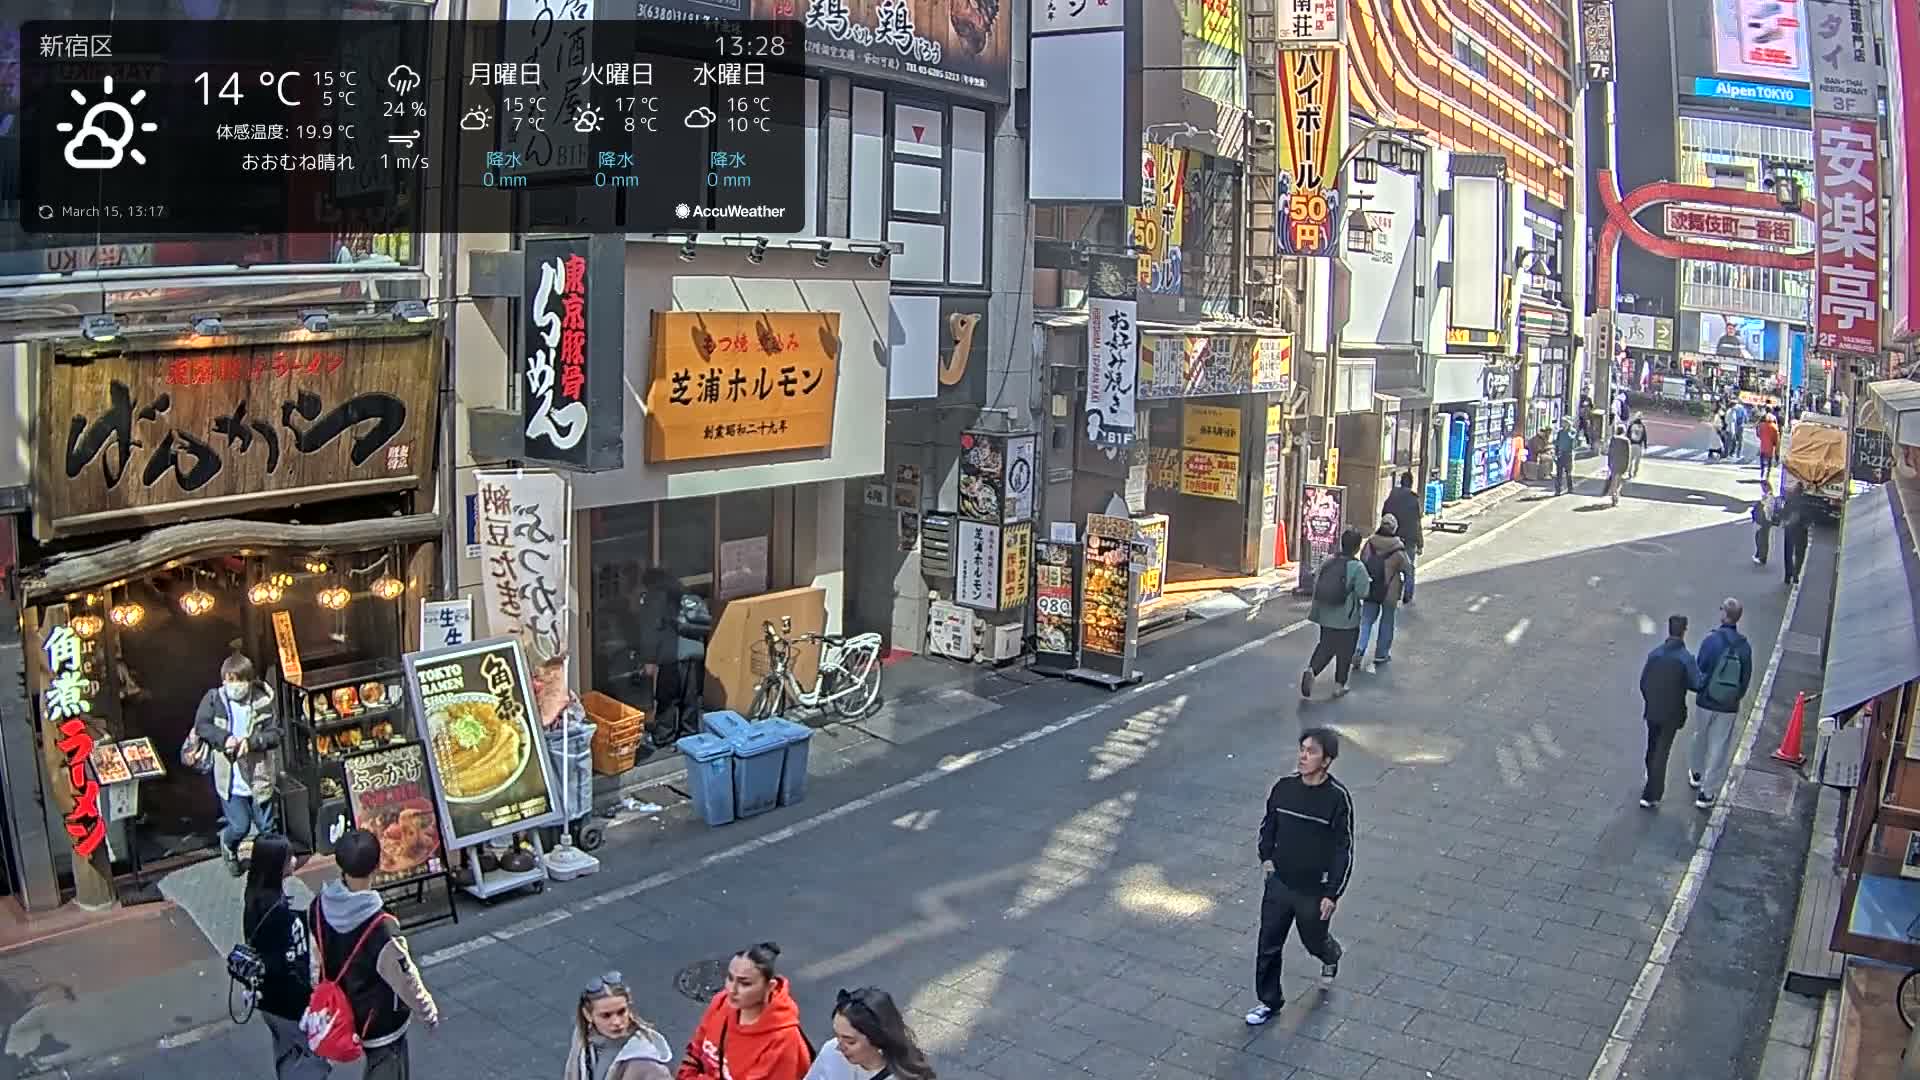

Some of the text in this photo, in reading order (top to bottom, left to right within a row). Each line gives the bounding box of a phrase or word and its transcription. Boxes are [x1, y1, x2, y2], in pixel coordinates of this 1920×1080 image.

[1589, 63, 1610, 78] 7F
[1296, 54, 1323, 190] ハイボール
[1670, 211, 1791, 241] 歌舞伎町一番街
[1818, 126, 1876, 329] 安楽亭
[560, 253, 587, 400] 東京豚骨
[1819, 331, 1837, 347] 2F
[1103, 309, 1132, 414] お好み焼き
[668, 366, 824, 405] 芝浦ホルモン
[418, 664, 463, 683] TOKYO
[421, 677, 465, 695] RAMEN
